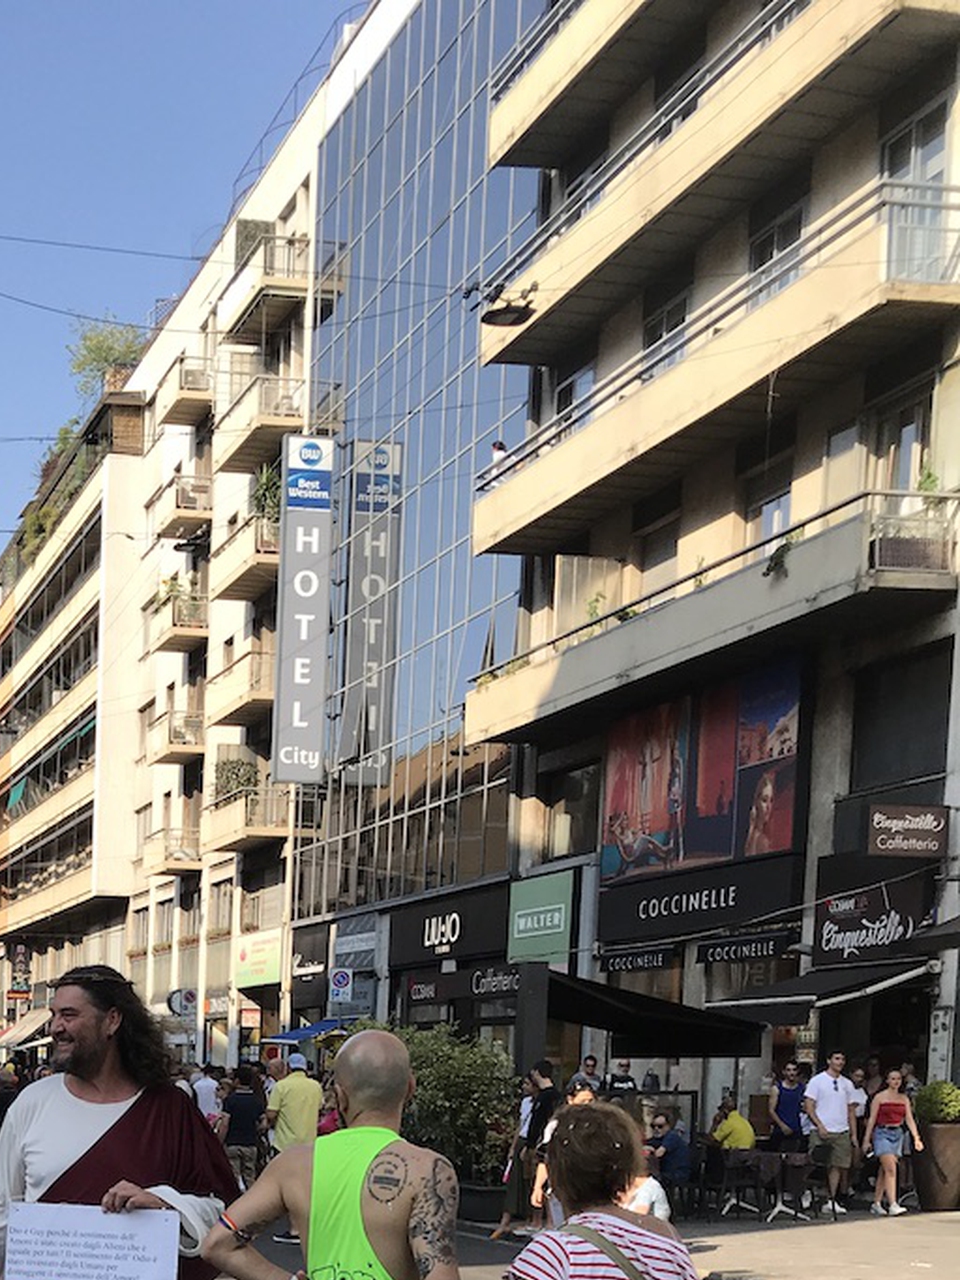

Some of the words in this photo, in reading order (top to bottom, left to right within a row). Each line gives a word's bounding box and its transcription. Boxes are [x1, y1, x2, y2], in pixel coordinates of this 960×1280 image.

[297, 478, 320, 490] Best
[288, 487, 329, 499] Western
[291, 525, 320, 729] HOTEL
[279, 746, 319, 770] City
[876, 834, 939, 851] Caffetteria
[639, 886, 737, 919] COCCINELLE
[518, 911, 561, 931] WALTER
[707, 941, 775, 962] COCCINELLE
[608, 953, 663, 971] COCCINELLE
[80, 1231, 118, 1240] sentimento
[32, 1249, 44, 1258] per
[73, 1251, 113, 1260] sentimento
[132, 1254, 151, 1263] Odio
[127, 1243, 141, 1252] che
[106, 1264, 118, 1272] per
